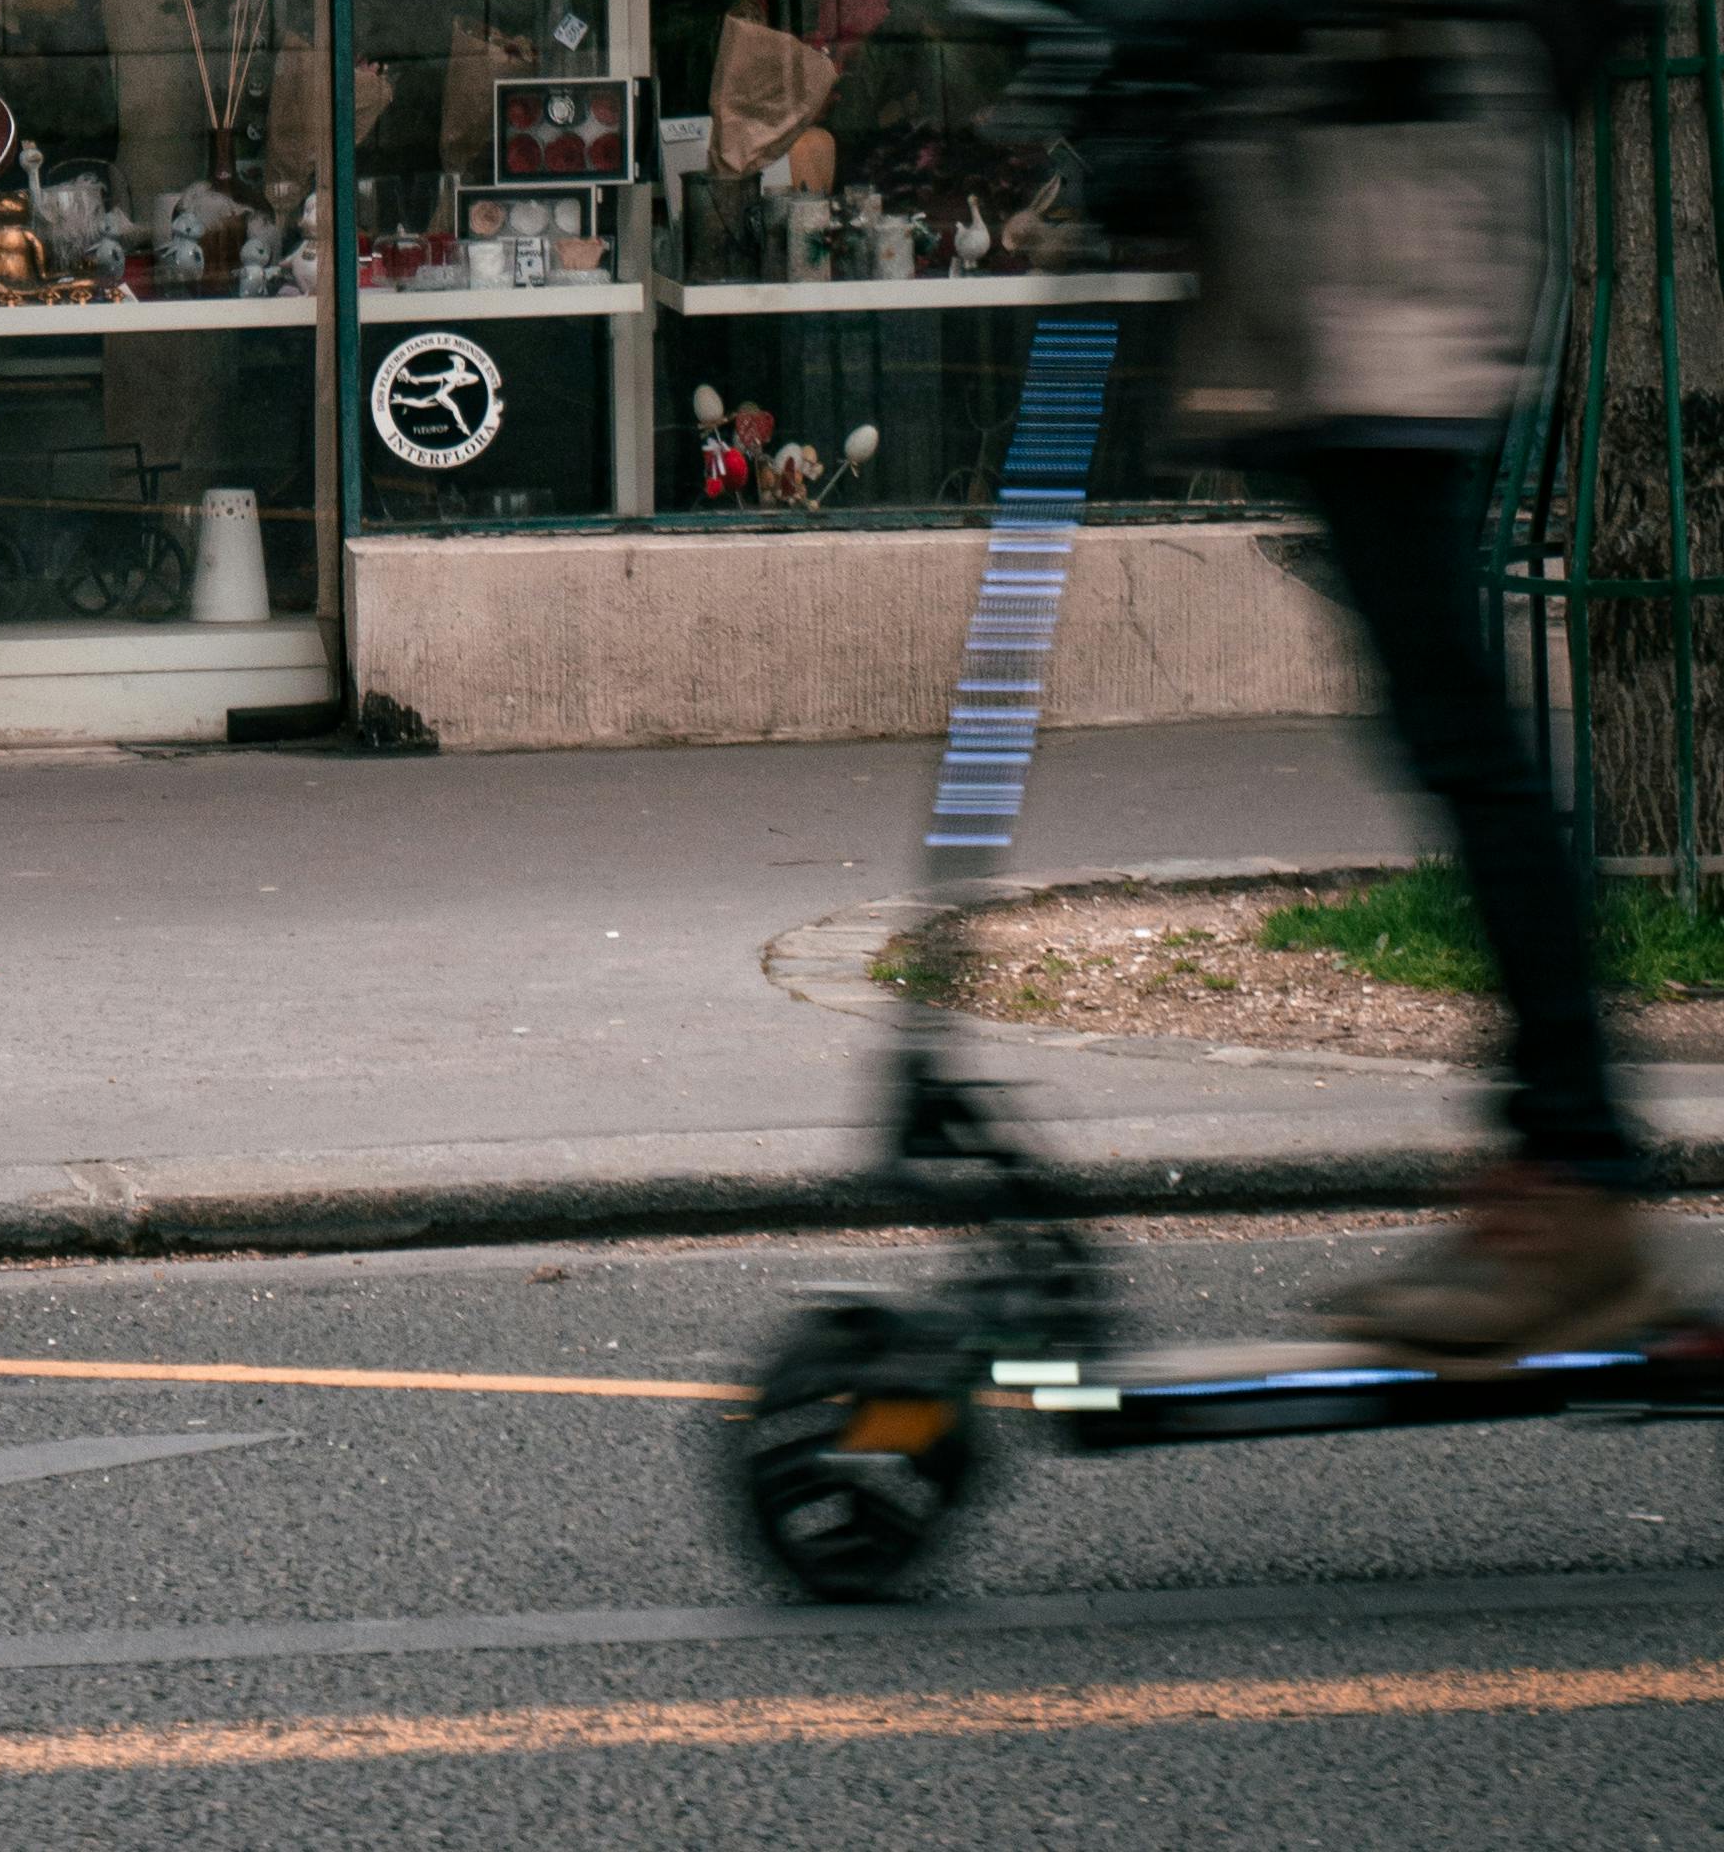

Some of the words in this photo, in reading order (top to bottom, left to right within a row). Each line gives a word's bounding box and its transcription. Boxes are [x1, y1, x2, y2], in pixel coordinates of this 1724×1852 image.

[406, 338, 435, 354] DANS
[437, 337, 451, 345] LE
[387, 425, 496, 464] INTERFLORA
